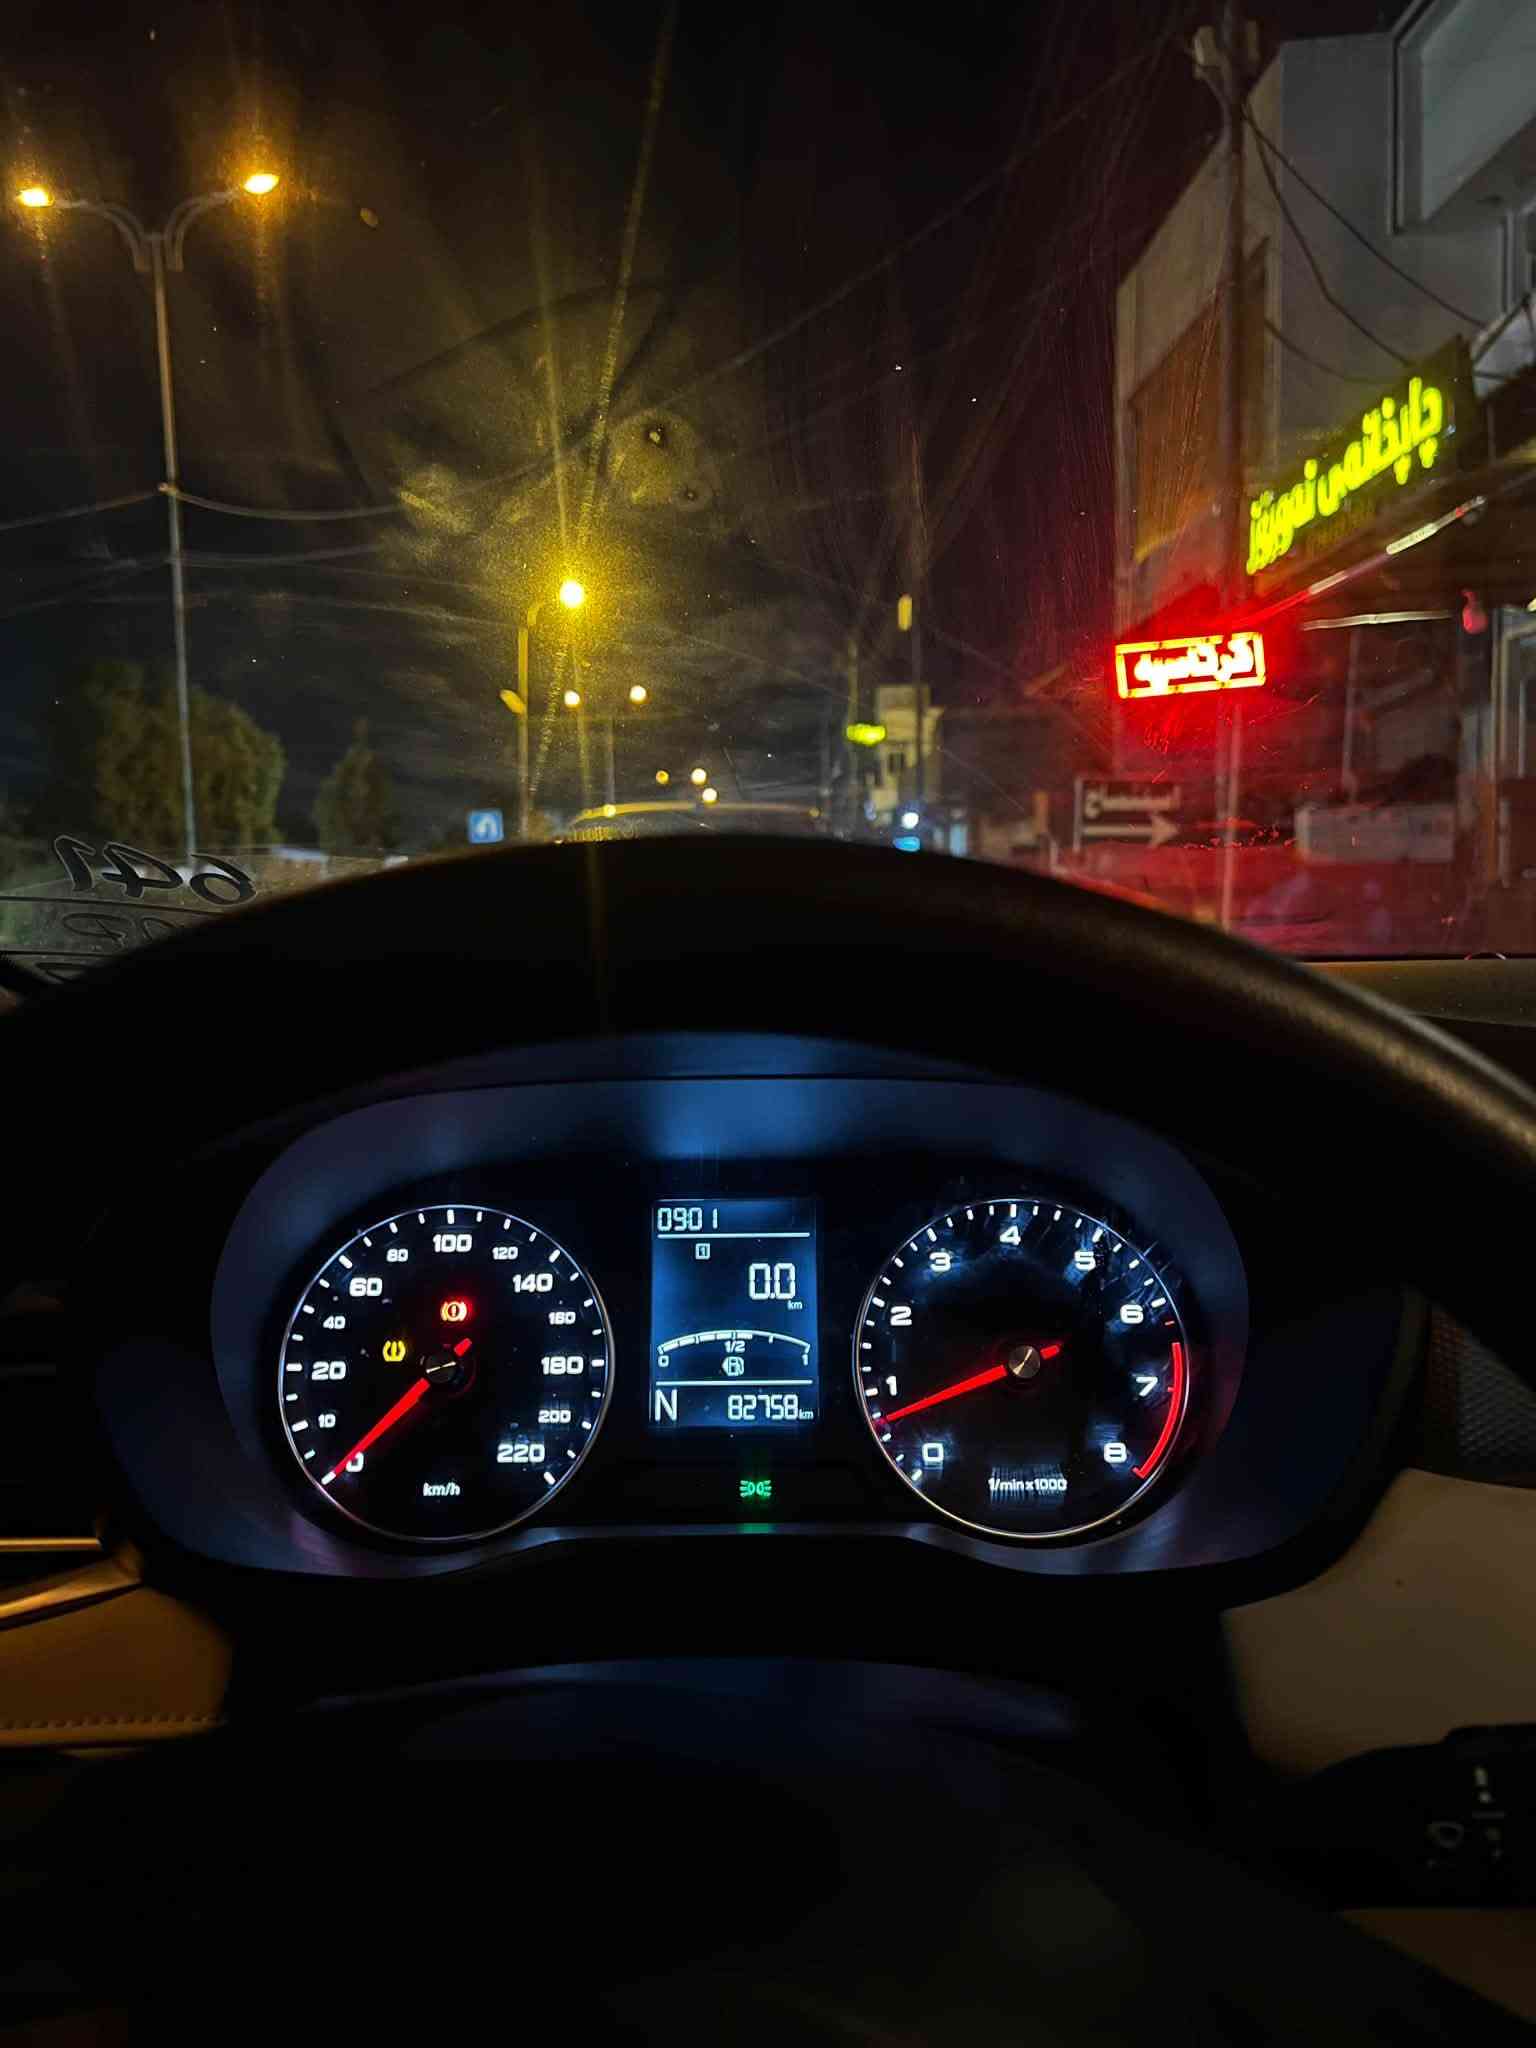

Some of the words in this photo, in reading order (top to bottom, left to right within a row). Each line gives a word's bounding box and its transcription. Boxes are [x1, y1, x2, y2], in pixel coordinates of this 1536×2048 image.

[433, 1234, 472, 1253] 100
[999, 1225, 1022, 1247] 4
[387, 1249, 408, 1263] 80
[492, 1246, 518, 1260] 120
[930, 1251, 952, 1273] 3
[1074, 1251, 1096, 1271] 5
[349, 1277, 383, 1297] 60
[512, 1273, 553, 1293] 140
[748, 1262, 797, 1301] 0.0
[787, 1299, 804, 1311] km
[1119, 1304, 1144, 1324] 6
[323, 1316, 346, 1330] 40
[549, 1311, 576, 1325] 160
[890, 1306, 912, 1326] 2
[724, 1340, 745, 1354] 1/2
[312, 1361, 345, 1381] 20
[541, 1356, 583, 1375] 180
[885, 1375, 898, 1396] 1
[1135, 1376, 1160, 1396] 7
[654, 1388, 677, 1421] N
[726, 1393, 798, 1421] 82758
[318, 1414, 337, 1429] 10
[538, 1407, 572, 1424] 200
[497, 1443, 545, 1463] 220
[922, 1442, 944, 1464] 0
[1103, 1442, 1128, 1464] 8
[423, 1482, 460, 1496] km/h
